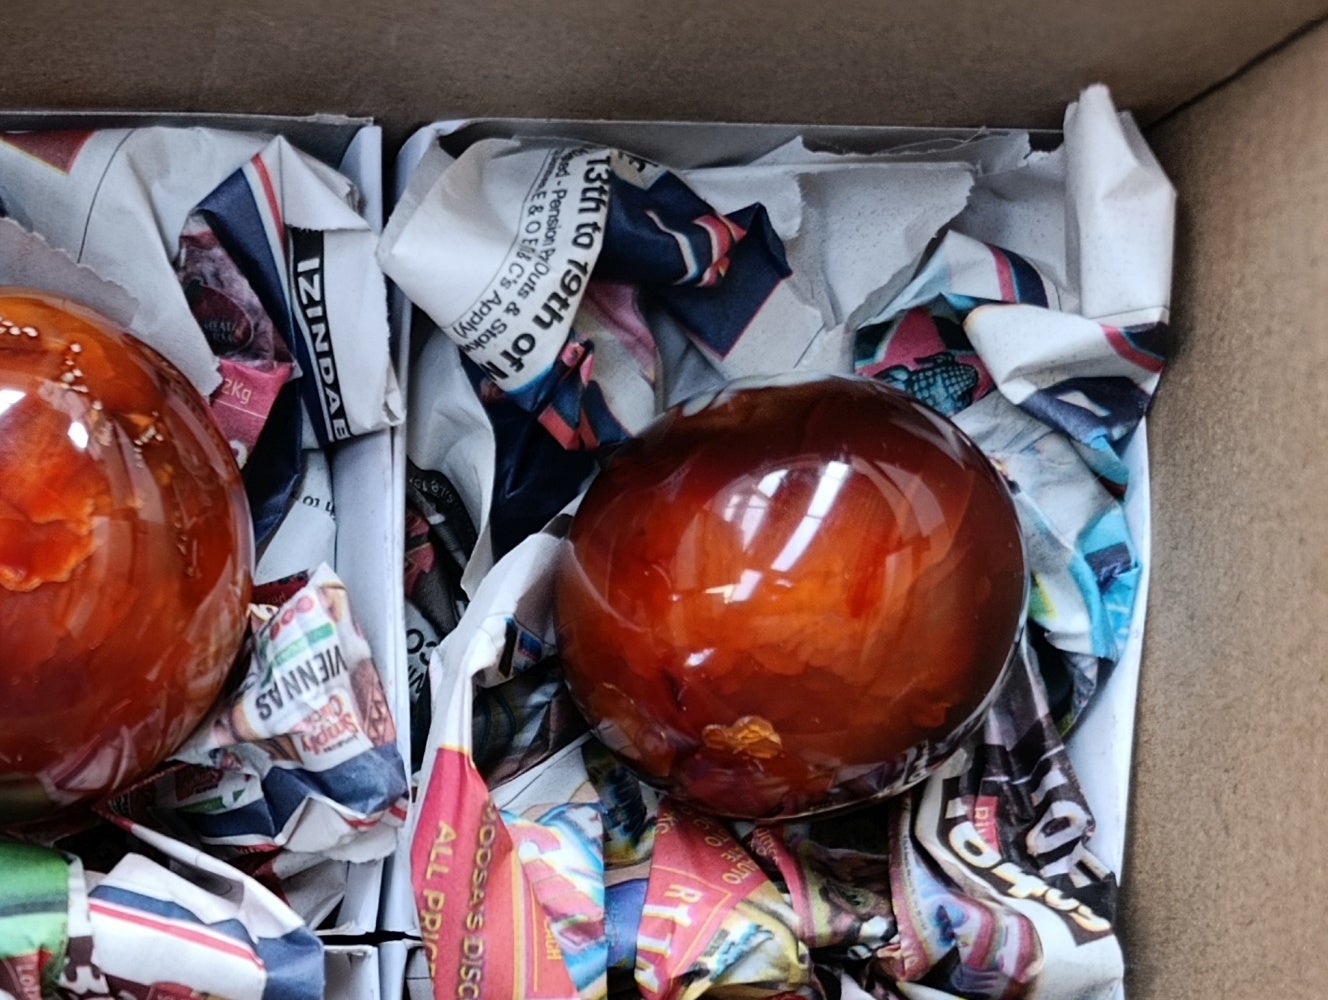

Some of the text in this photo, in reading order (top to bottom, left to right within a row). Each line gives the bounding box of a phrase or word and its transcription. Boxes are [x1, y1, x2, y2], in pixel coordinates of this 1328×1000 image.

[500, 154, 610, 374] 13th to 19th of
[256, 645, 349, 722] VIENNAS
[425, 821, 457, 881] ALL
